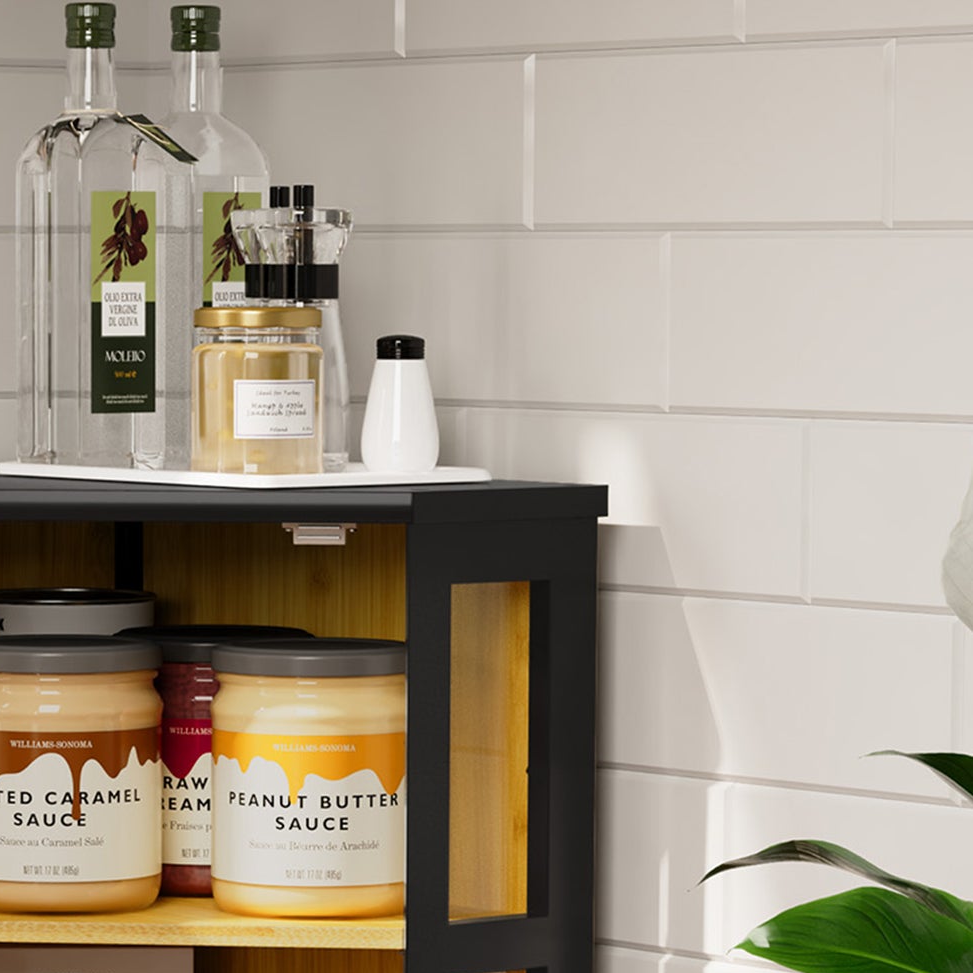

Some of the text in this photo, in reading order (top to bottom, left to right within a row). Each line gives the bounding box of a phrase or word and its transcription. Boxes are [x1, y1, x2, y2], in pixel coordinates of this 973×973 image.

[104, 292, 142, 302] OLIO EXTRA
[109, 304, 138, 314] VERGINE
[118, 316, 139, 327] OLIVA
[168, 726, 213, 736] WILLIAMS
[9, 739, 93, 749] WILLIAMS-SONOMA
[272, 743, 357, 753] WILLIAMS-SONOMA
[163, 776, 208, 790] RAW
[44, 788, 142, 806] CARAMEL
[228, 791, 399, 809] PEANUT BUTTER
[13, 812, 87, 827] SAUCE
[275, 816, 350, 831] SAUCE
[169, 820, 204, 831] Fraises
[0, 835, 105, 848] Sauce au Caramel Salé
[324, 841, 338, 851] de
